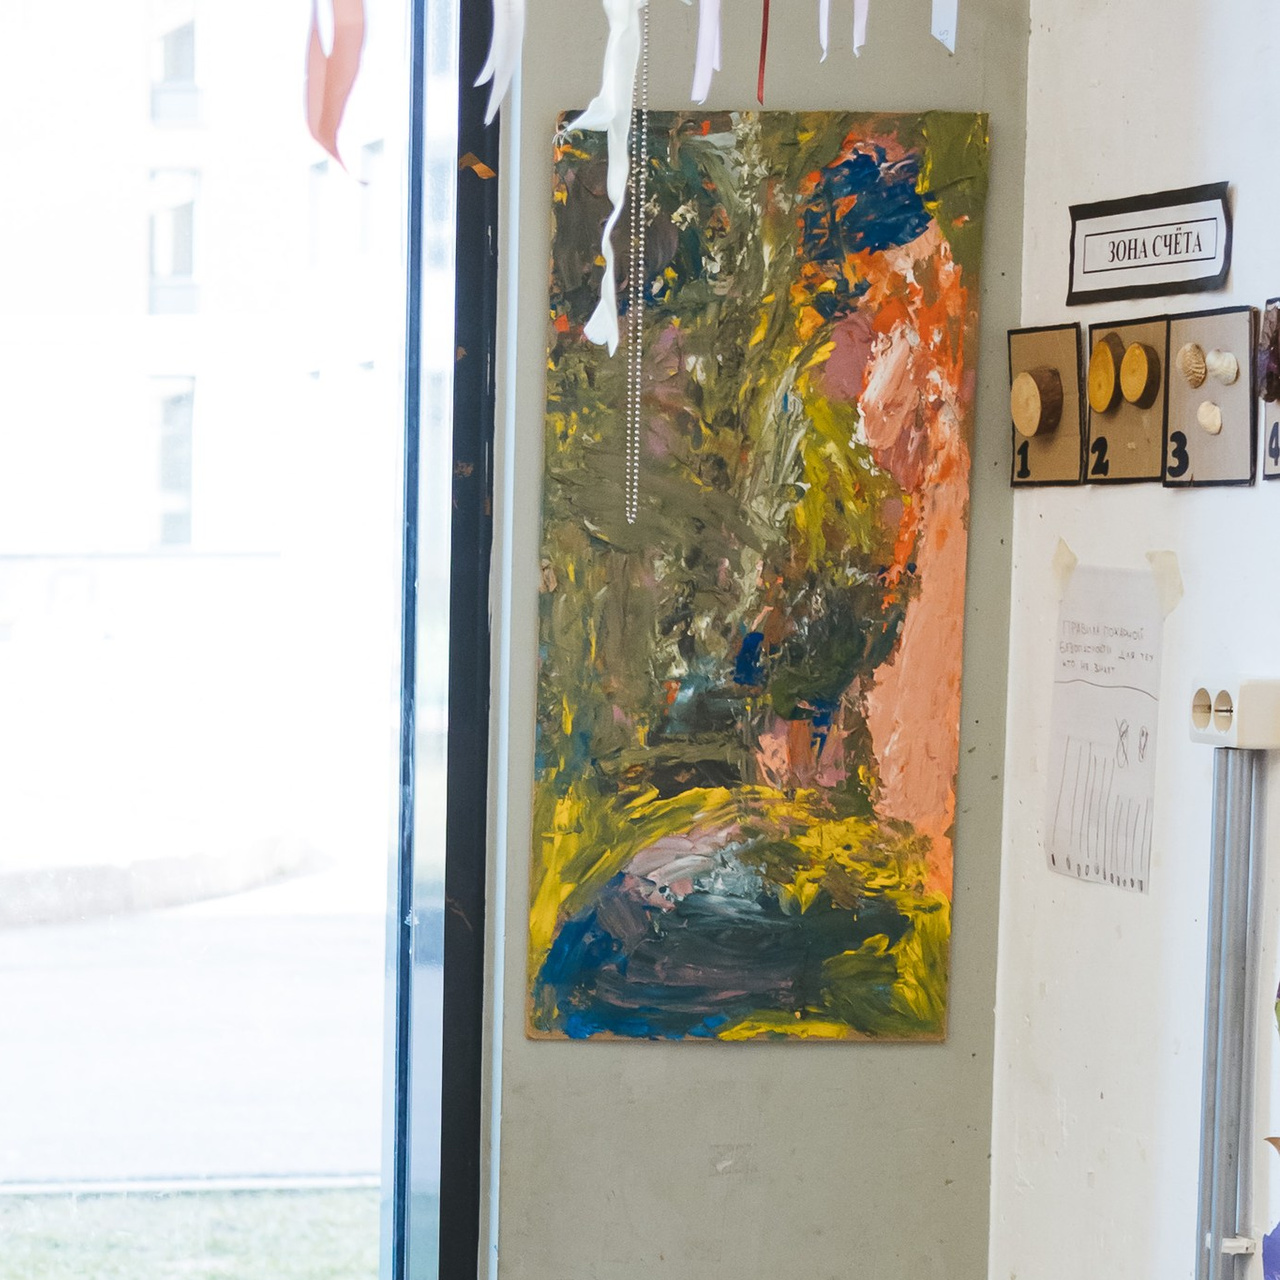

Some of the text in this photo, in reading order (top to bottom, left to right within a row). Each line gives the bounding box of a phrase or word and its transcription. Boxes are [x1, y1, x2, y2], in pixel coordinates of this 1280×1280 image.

[1108, 227, 1202, 262] ЗОНА СЧЁТА
[1017, 440, 1030, 478] 1
[1091, 437, 1109, 476] 2
[1168, 431, 1189, 477] 3
